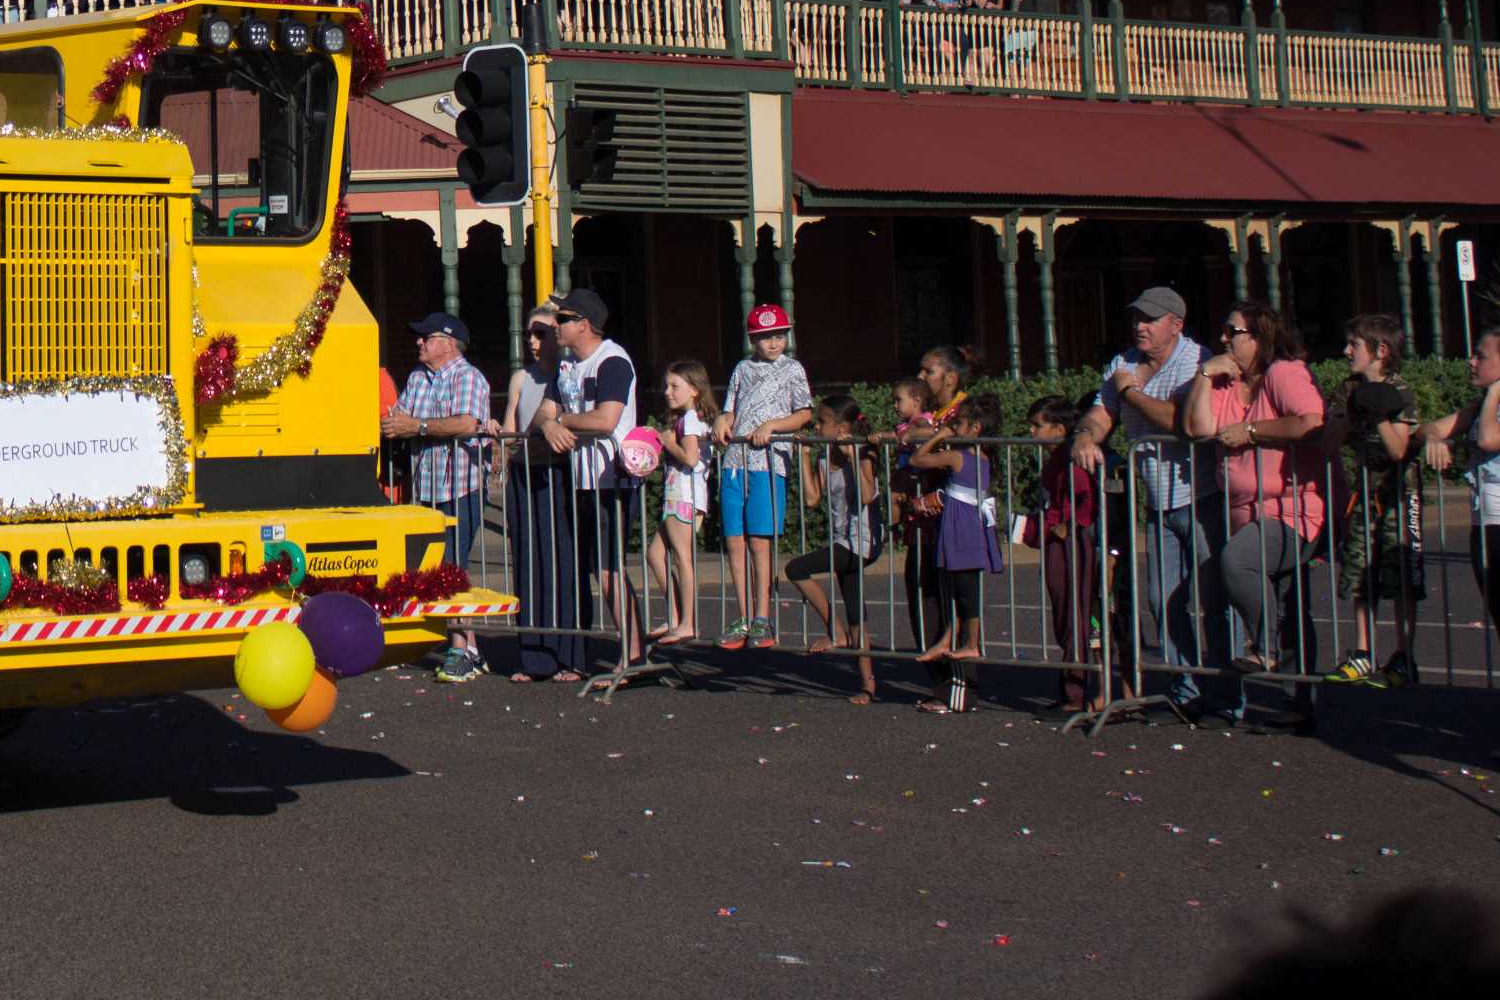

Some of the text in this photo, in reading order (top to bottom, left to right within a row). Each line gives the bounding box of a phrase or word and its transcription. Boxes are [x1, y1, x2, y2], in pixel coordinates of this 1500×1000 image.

[89, 436, 140, 455] TRUCK
[307, 555, 379, 574] Atlas Copco
